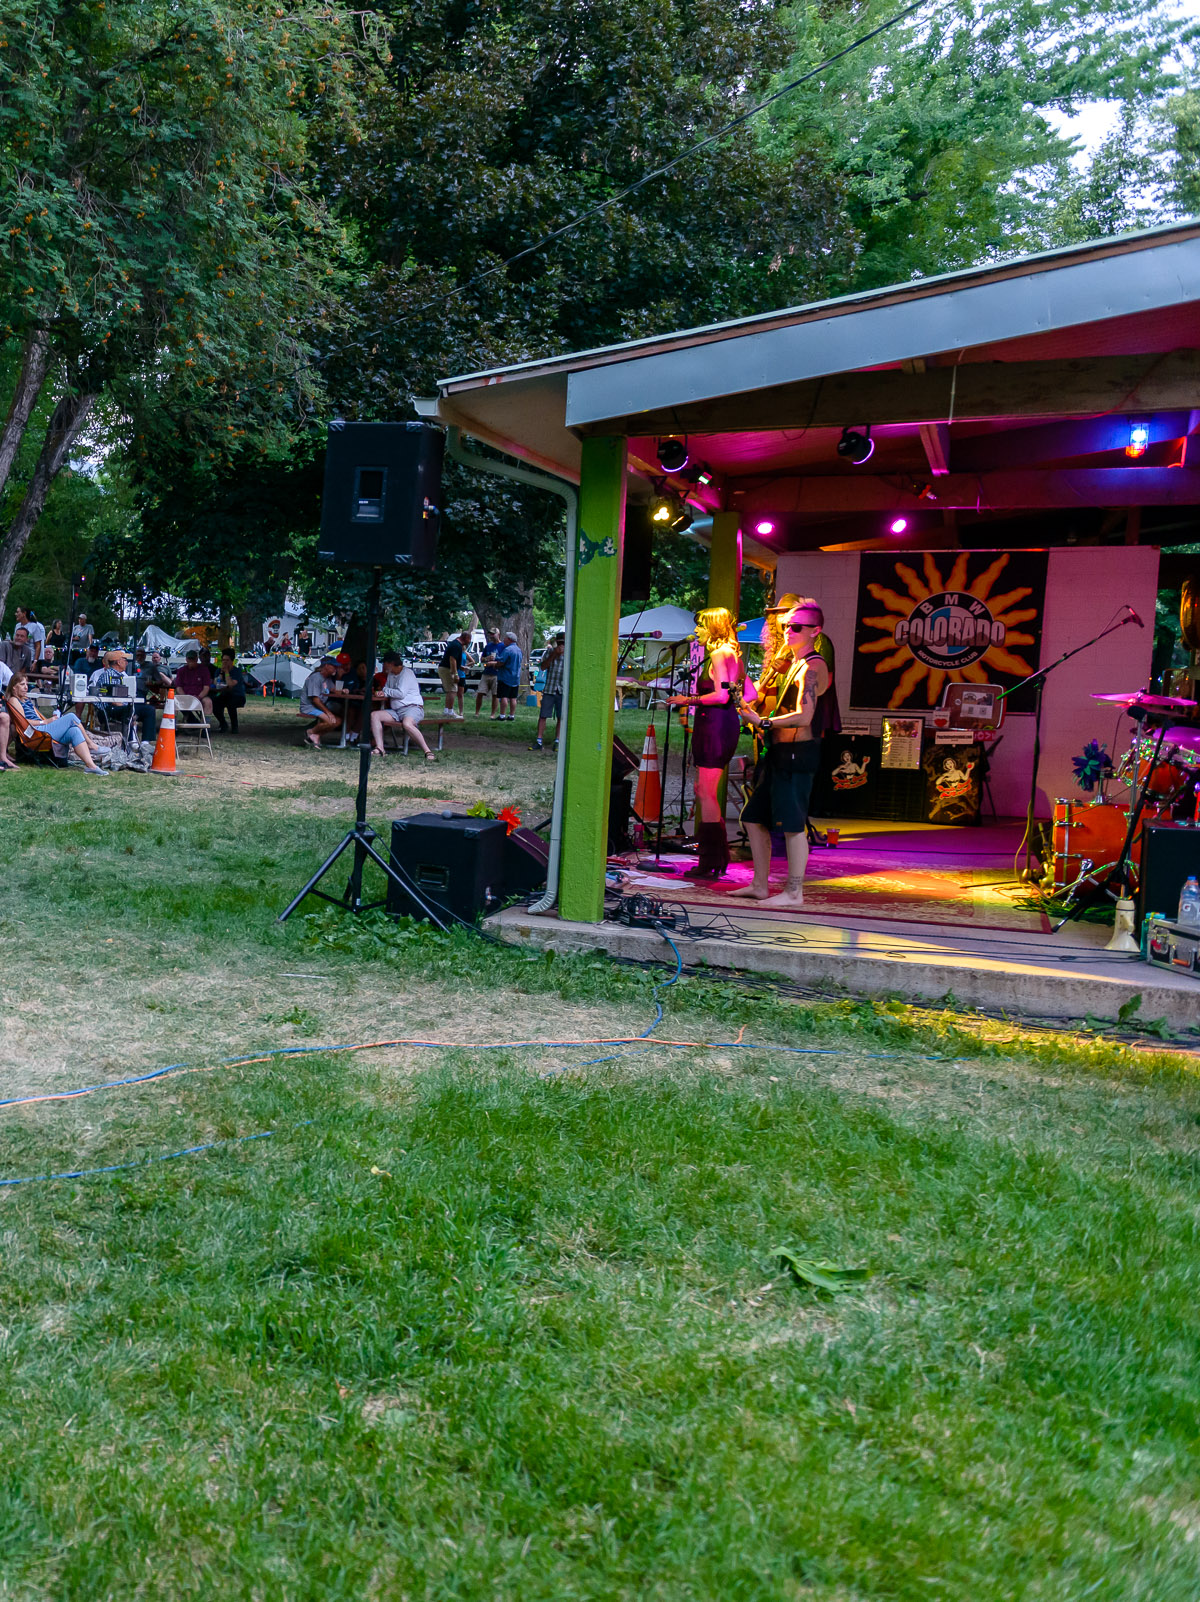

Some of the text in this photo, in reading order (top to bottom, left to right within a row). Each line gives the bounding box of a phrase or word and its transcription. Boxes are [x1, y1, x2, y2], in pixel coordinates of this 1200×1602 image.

[919, 594, 986, 615] BMW
[895, 616, 1005, 647] COLORADO
[917, 650, 979, 667] MOTORCYCLE CLUB
[1182, 903, 1191, 912] G
